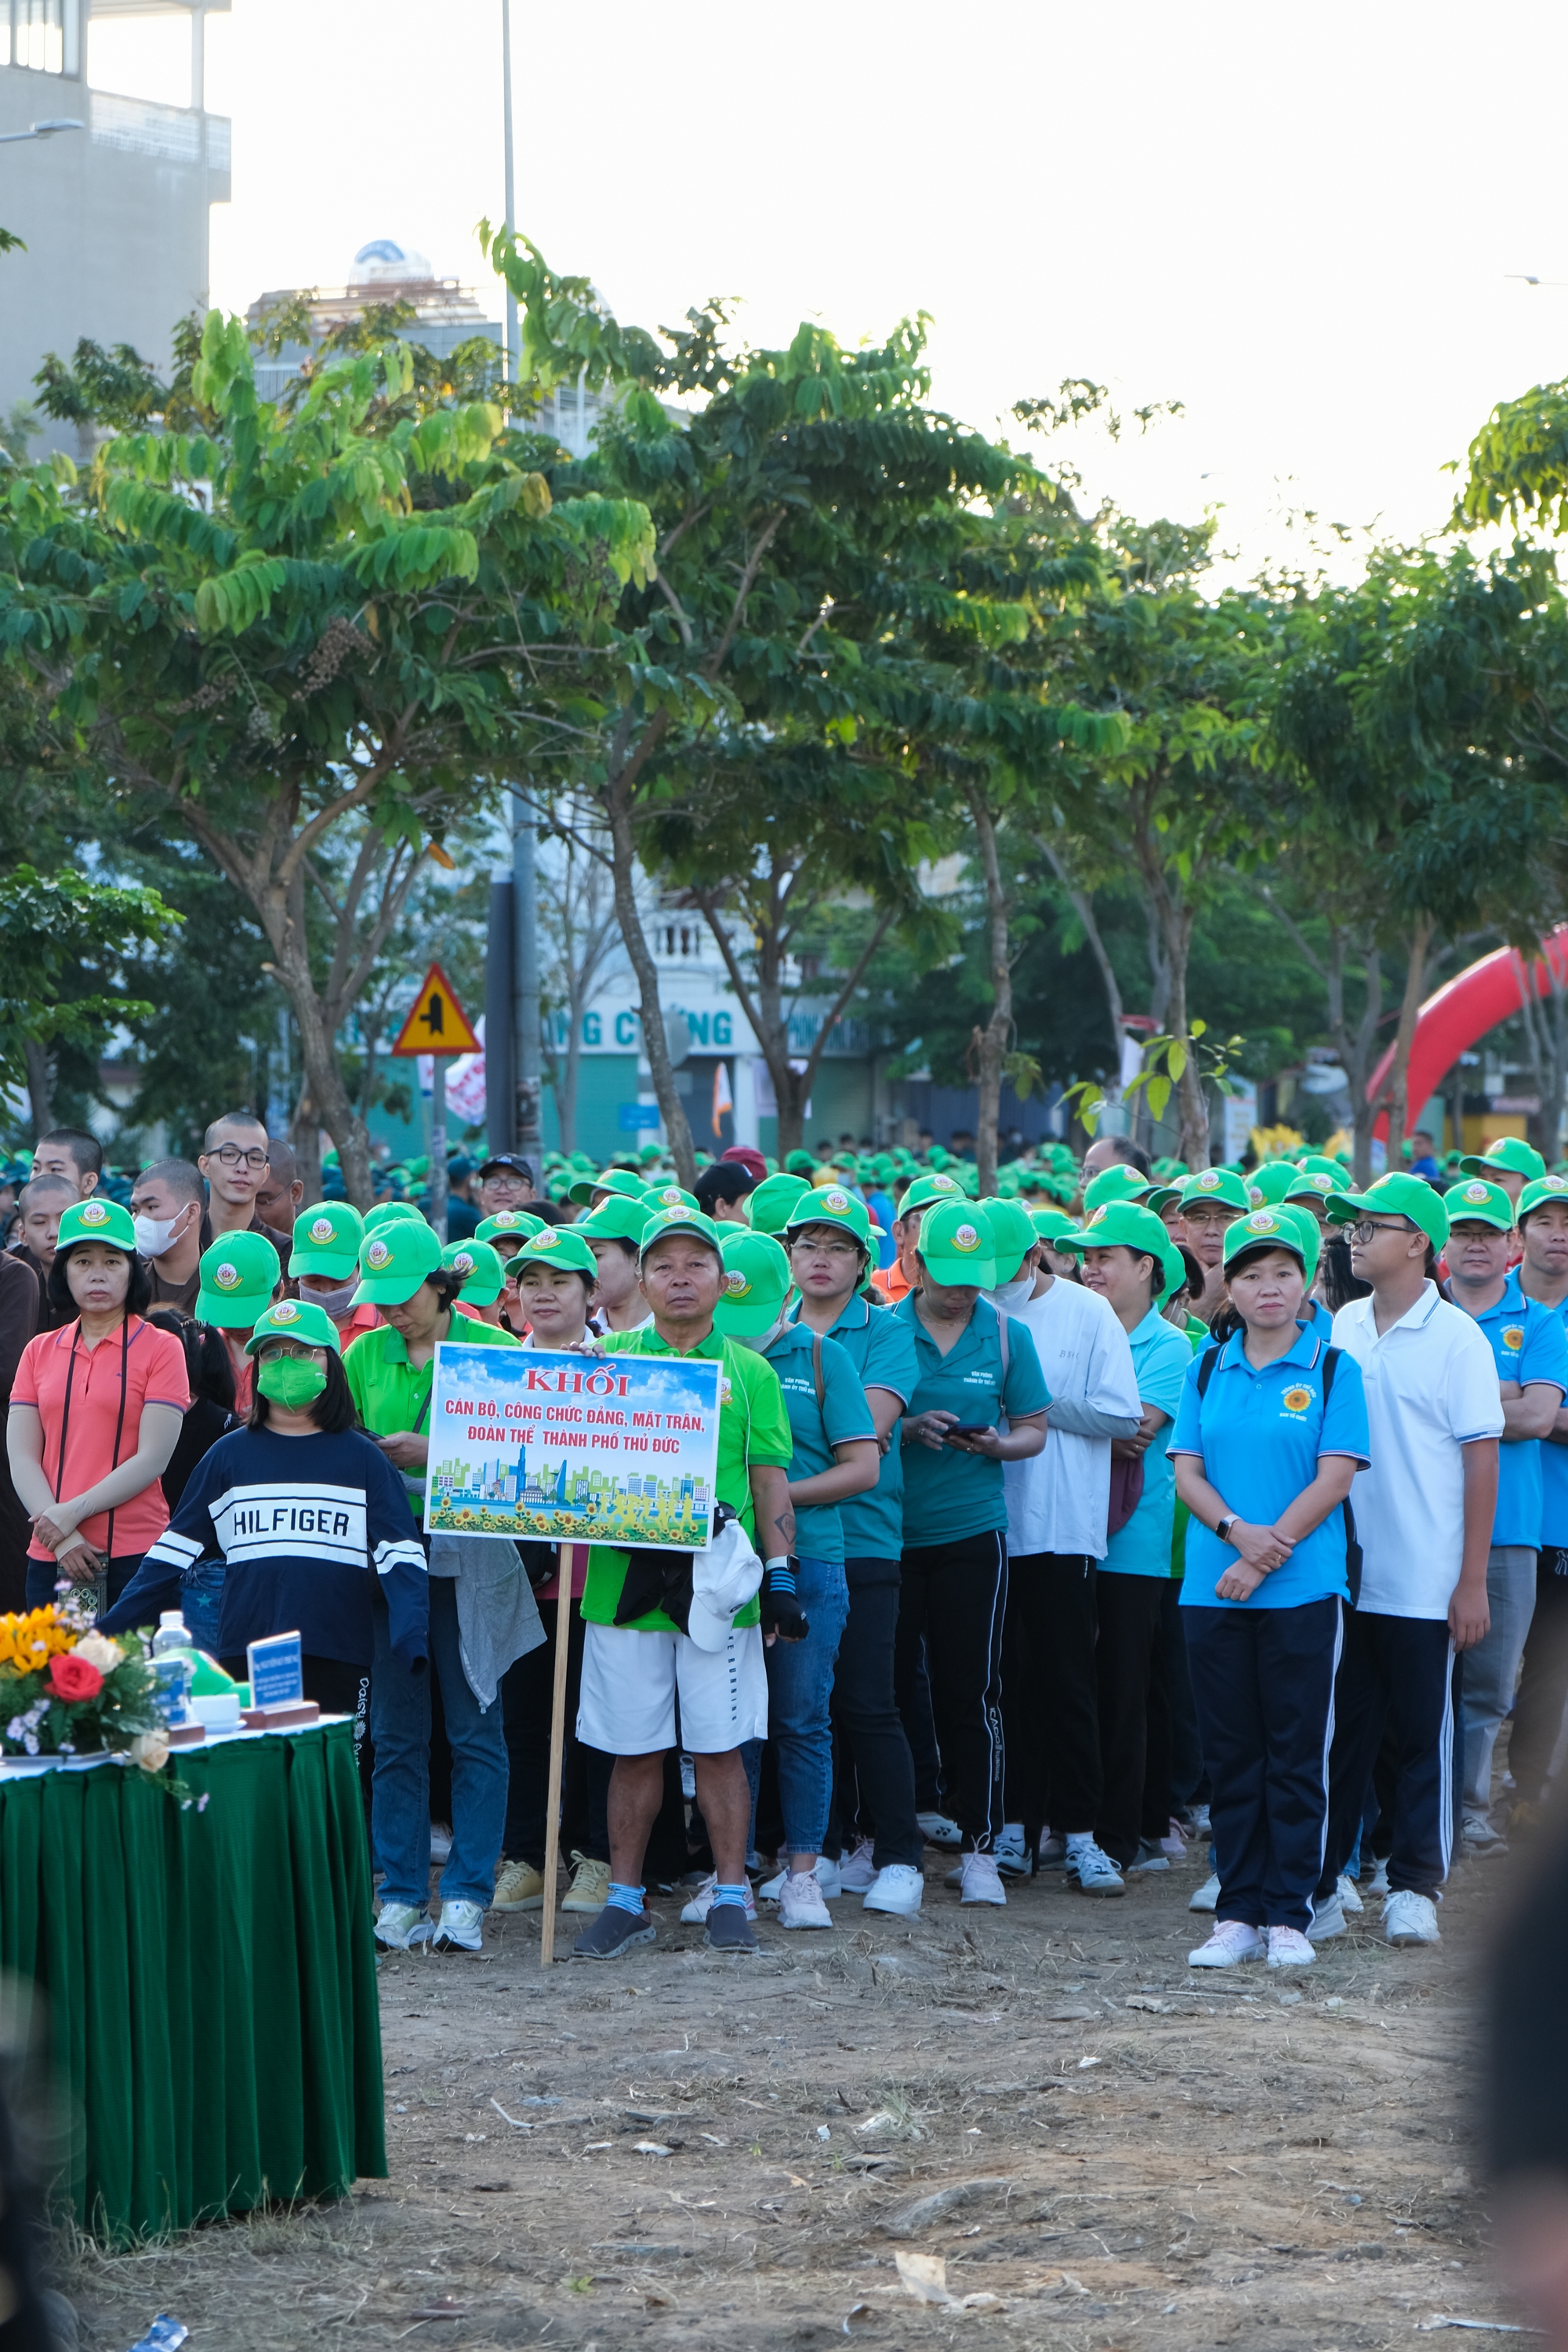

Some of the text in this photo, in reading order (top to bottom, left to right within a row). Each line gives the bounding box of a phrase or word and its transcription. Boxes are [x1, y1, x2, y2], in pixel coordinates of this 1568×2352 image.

[524, 1364, 630, 1397] KHỐI
[445, 1398, 706, 1433] CÁN BỘ, CÔNG CHỨC ĐẢNG, MẶT TRẬN,
[467, 1424, 681, 1454] ĐOÀN THỂ THÀNH PHỐ THỦ ĐỨC
[234, 1508, 350, 1537] HILFIGER
[355, 1677, 369, 1719] Daisy
[728, 1657, 737, 1722] RUNNING
